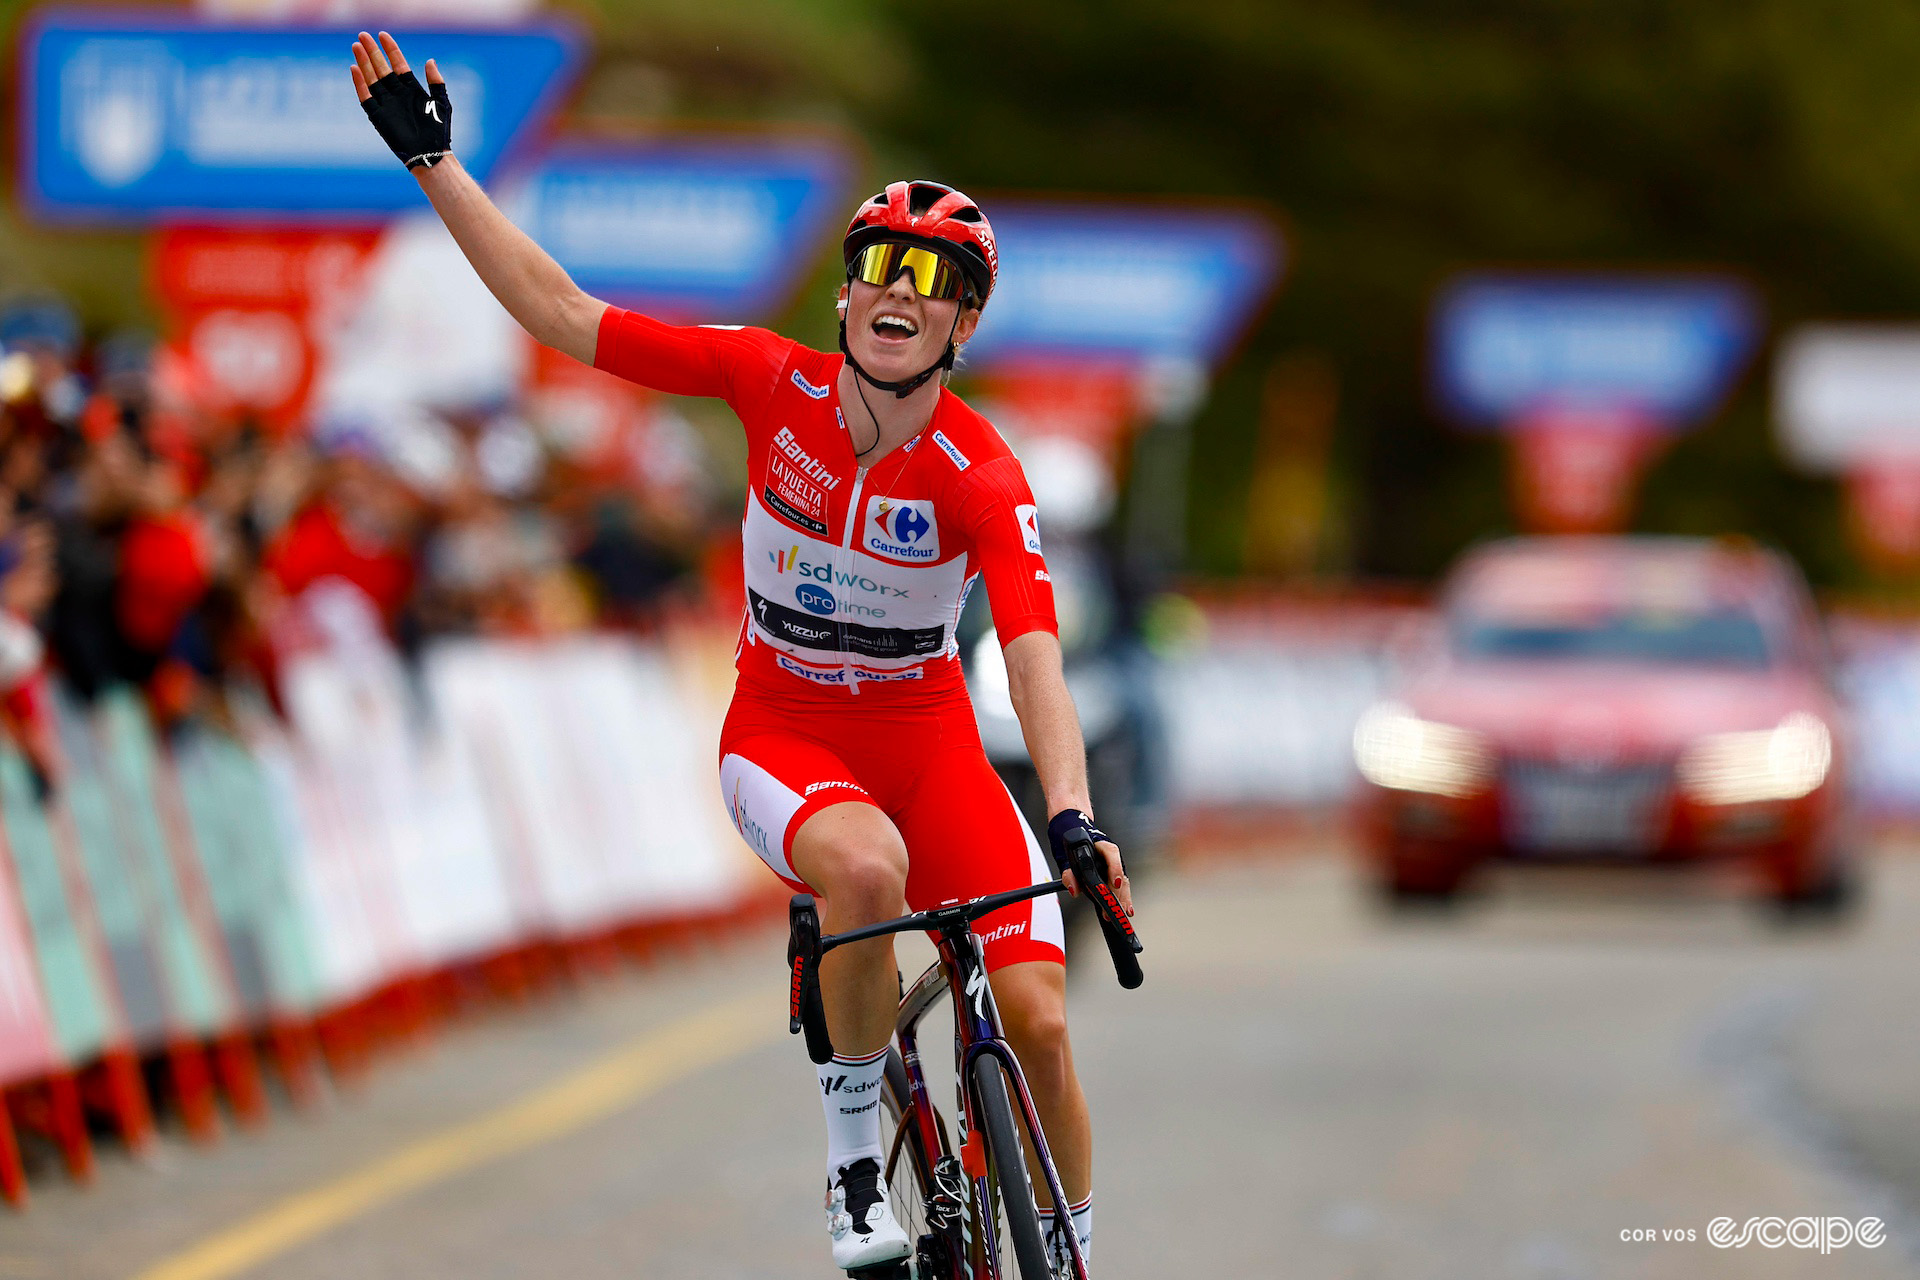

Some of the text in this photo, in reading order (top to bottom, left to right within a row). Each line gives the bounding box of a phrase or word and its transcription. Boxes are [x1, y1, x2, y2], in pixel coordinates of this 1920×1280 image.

[773, 425, 842, 491] Santini
[935, 432, 967, 469] Carrefour.es
[771, 455, 822, 508] LA VUELTA
[770, 495, 809, 526] Carrefour.es
[777, 481, 820, 518] FEMENINA 24
[871, 538, 934, 558] Carrefour
[798, 562, 910, 598] sdworx
[1035, 570, 1051, 582] Sa
[938, 908, 961, 917] GARMIN
[1095, 883, 1134, 935] SRAM
[980, 920, 1027, 946] antini
[791, 955, 804, 1018] SRAM
[843, 1075, 884, 1094] sdwo
[839, 1099, 878, 1115] SRAM
